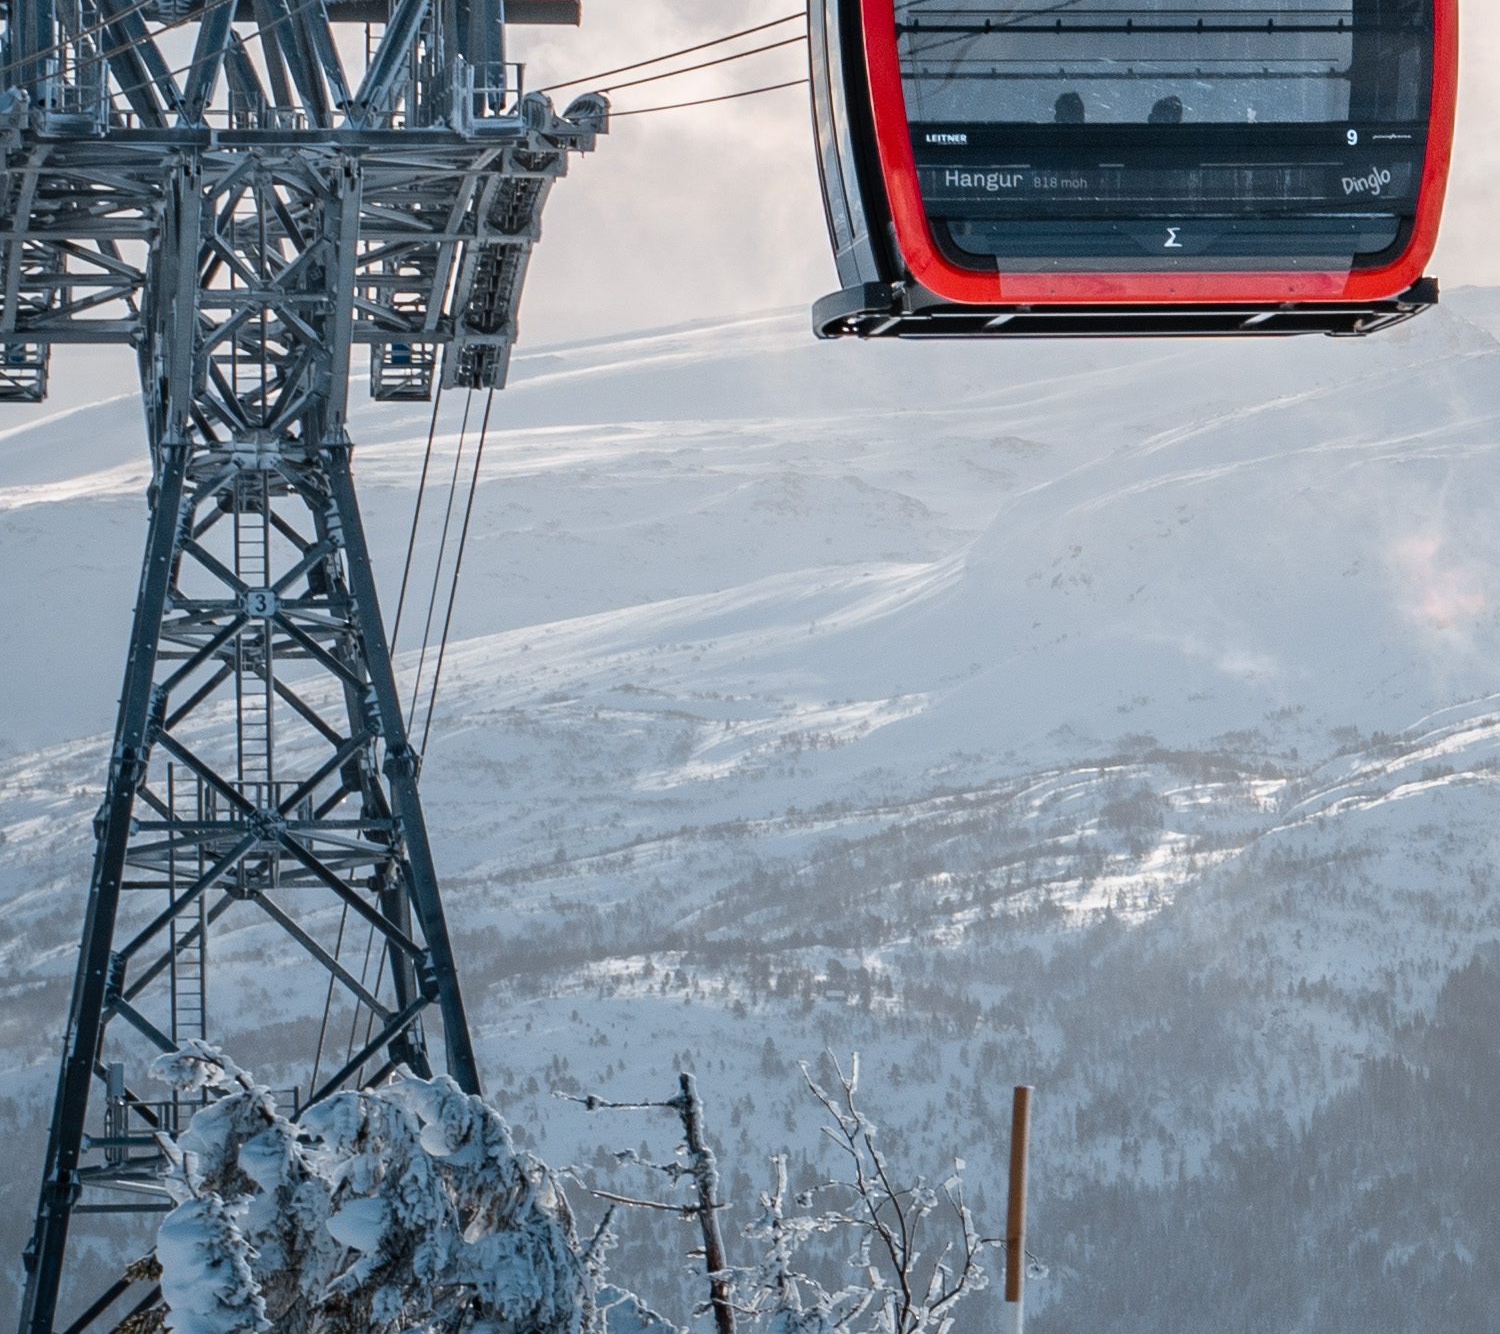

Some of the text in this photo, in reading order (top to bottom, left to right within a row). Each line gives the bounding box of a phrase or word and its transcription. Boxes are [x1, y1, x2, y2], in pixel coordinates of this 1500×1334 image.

[926, 133, 967, 143] LEITNER
[1346, 129, 1358, 146] 9
[945, 170, 1088, 192] Hangur 818 moh
[1341, 166, 1391, 196] Dinglo
[255, 593, 267, 613] 3
